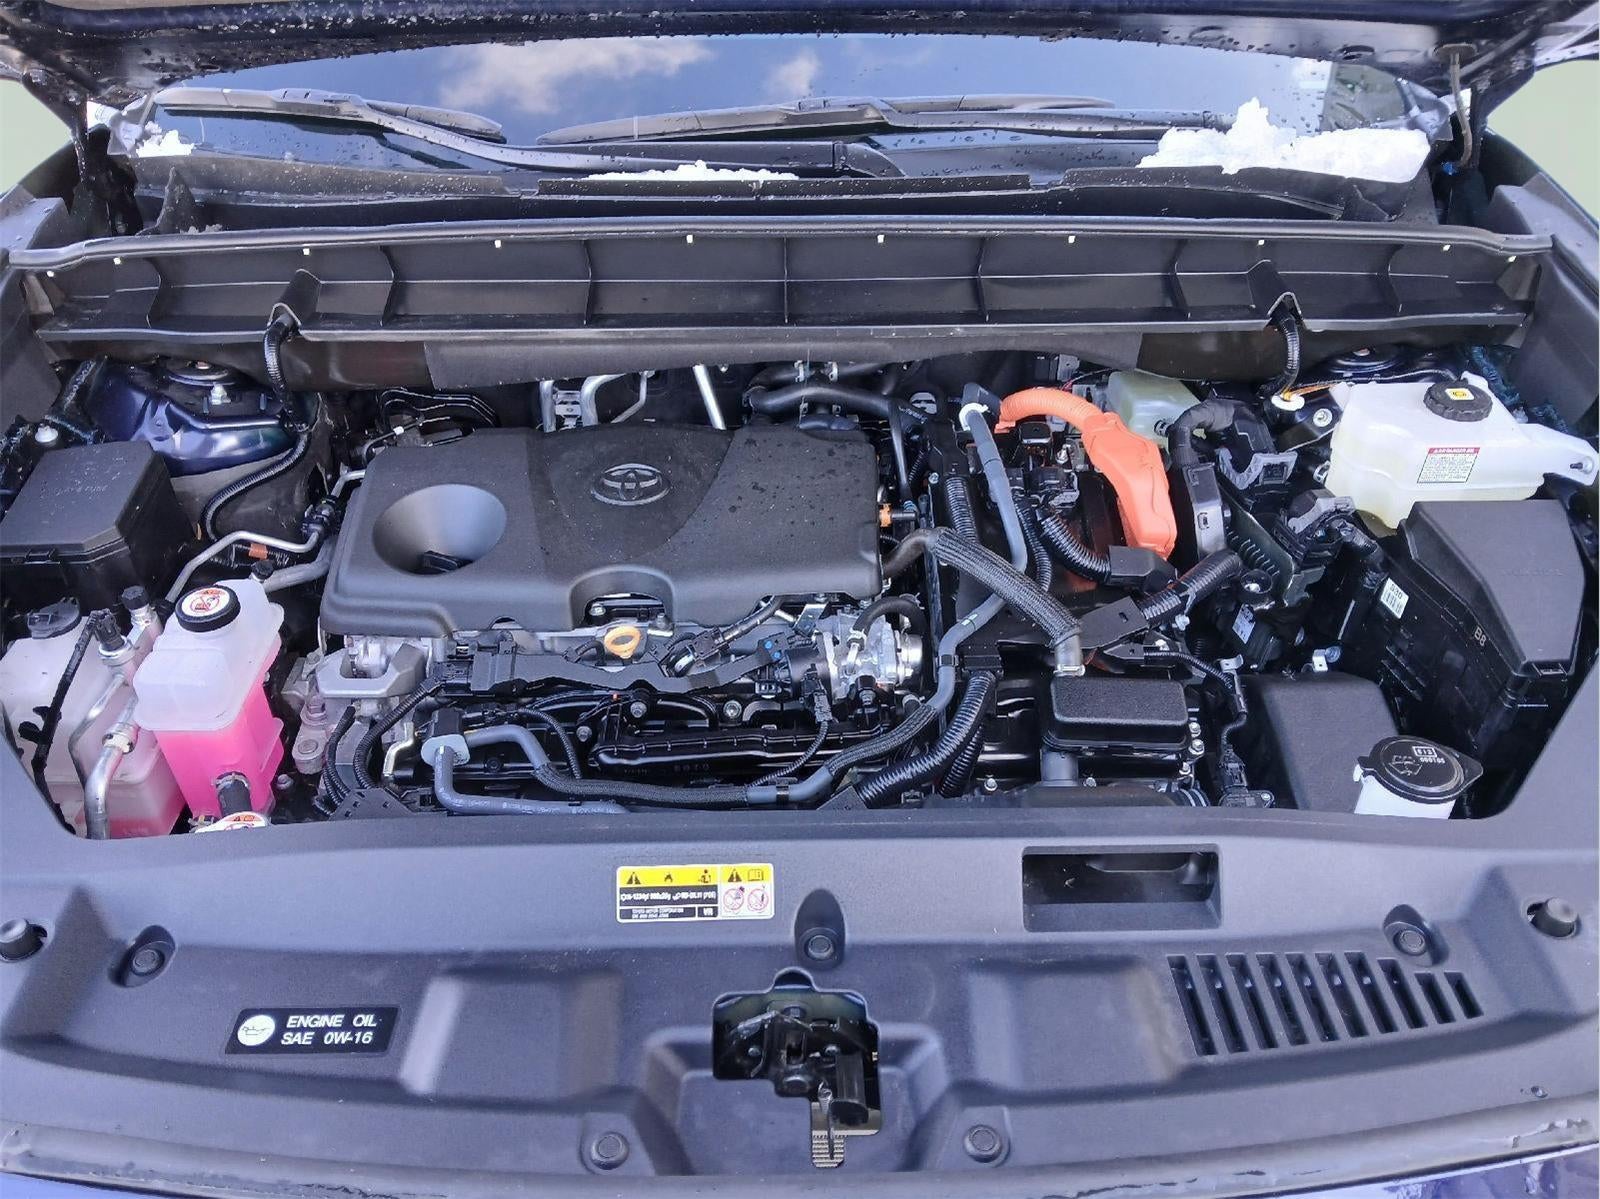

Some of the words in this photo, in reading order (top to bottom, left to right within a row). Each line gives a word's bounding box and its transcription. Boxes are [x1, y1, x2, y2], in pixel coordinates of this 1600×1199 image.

[1474, 626, 1487, 646] B8
[286, 1014, 345, 1028] ENGINE
[352, 1014, 377, 1027] OIL
[280, 1031, 315, 1045] SAE
[323, 1031, 374, 1045] 0W-16
